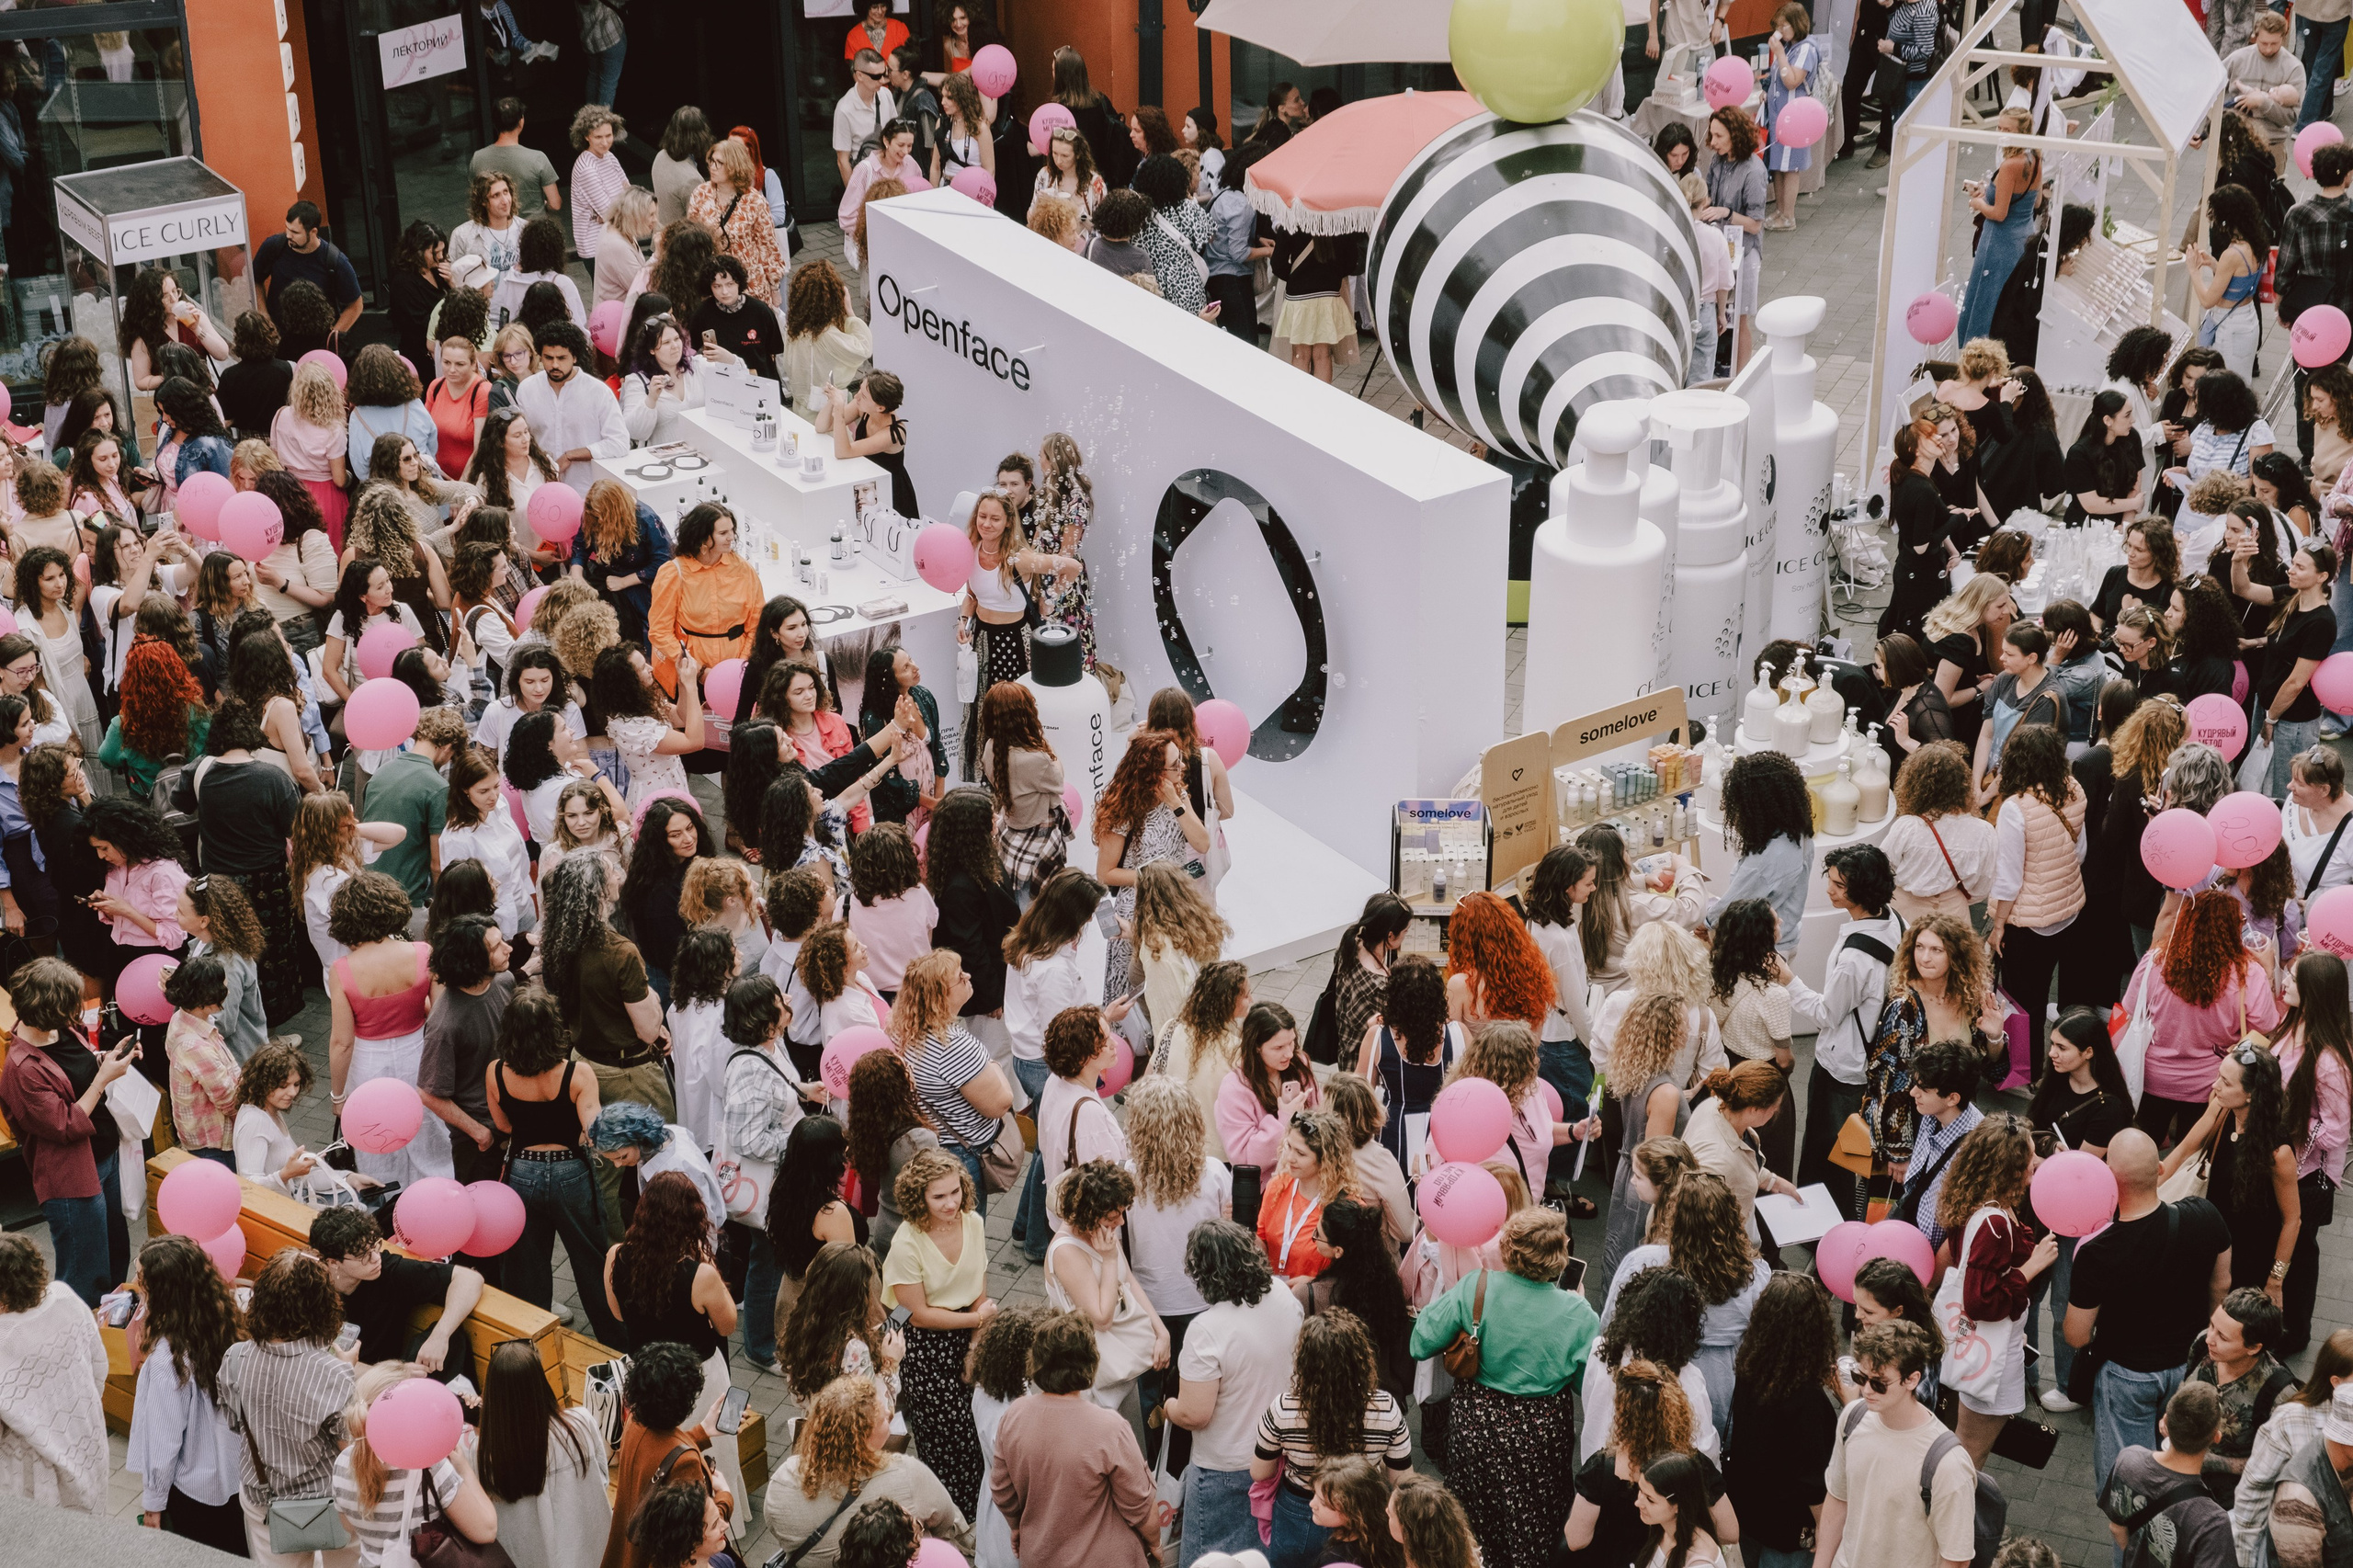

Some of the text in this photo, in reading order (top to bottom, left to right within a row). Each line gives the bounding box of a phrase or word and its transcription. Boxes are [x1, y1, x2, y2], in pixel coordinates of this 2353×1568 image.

[392, 34, 448, 58] ЛЕКТОРИЙ
[979, 186, 995, 201] КУДРЯ
[113, 212, 239, 253] ICE CURLY
[878, 274, 1030, 392] Openface
[710, 397, 734, 408] Openface
[1764, 510, 1778, 535] CUR
[1776, 557, 1808, 574] ICE
[1688, 680, 1722, 699] ICE
[1580, 709, 1657, 744] somelove
[2198, 725, 2236, 738] КУДРЯВЫЙ
[1089, 712, 1104, 805] enface
[1409, 808, 1471, 819] somelove
[2325, 932, 2353, 955] КУДРЯВ
[824, 1062, 842, 1088] МЕТОД
[830, 1054, 850, 1085] КУДРЯВ
[1433, 1165, 1456, 1187] МЕТОД
[1433, 1168, 1466, 1210] КУДРЯВЫЙ
[1958, 1326, 1968, 1337] ТОД
